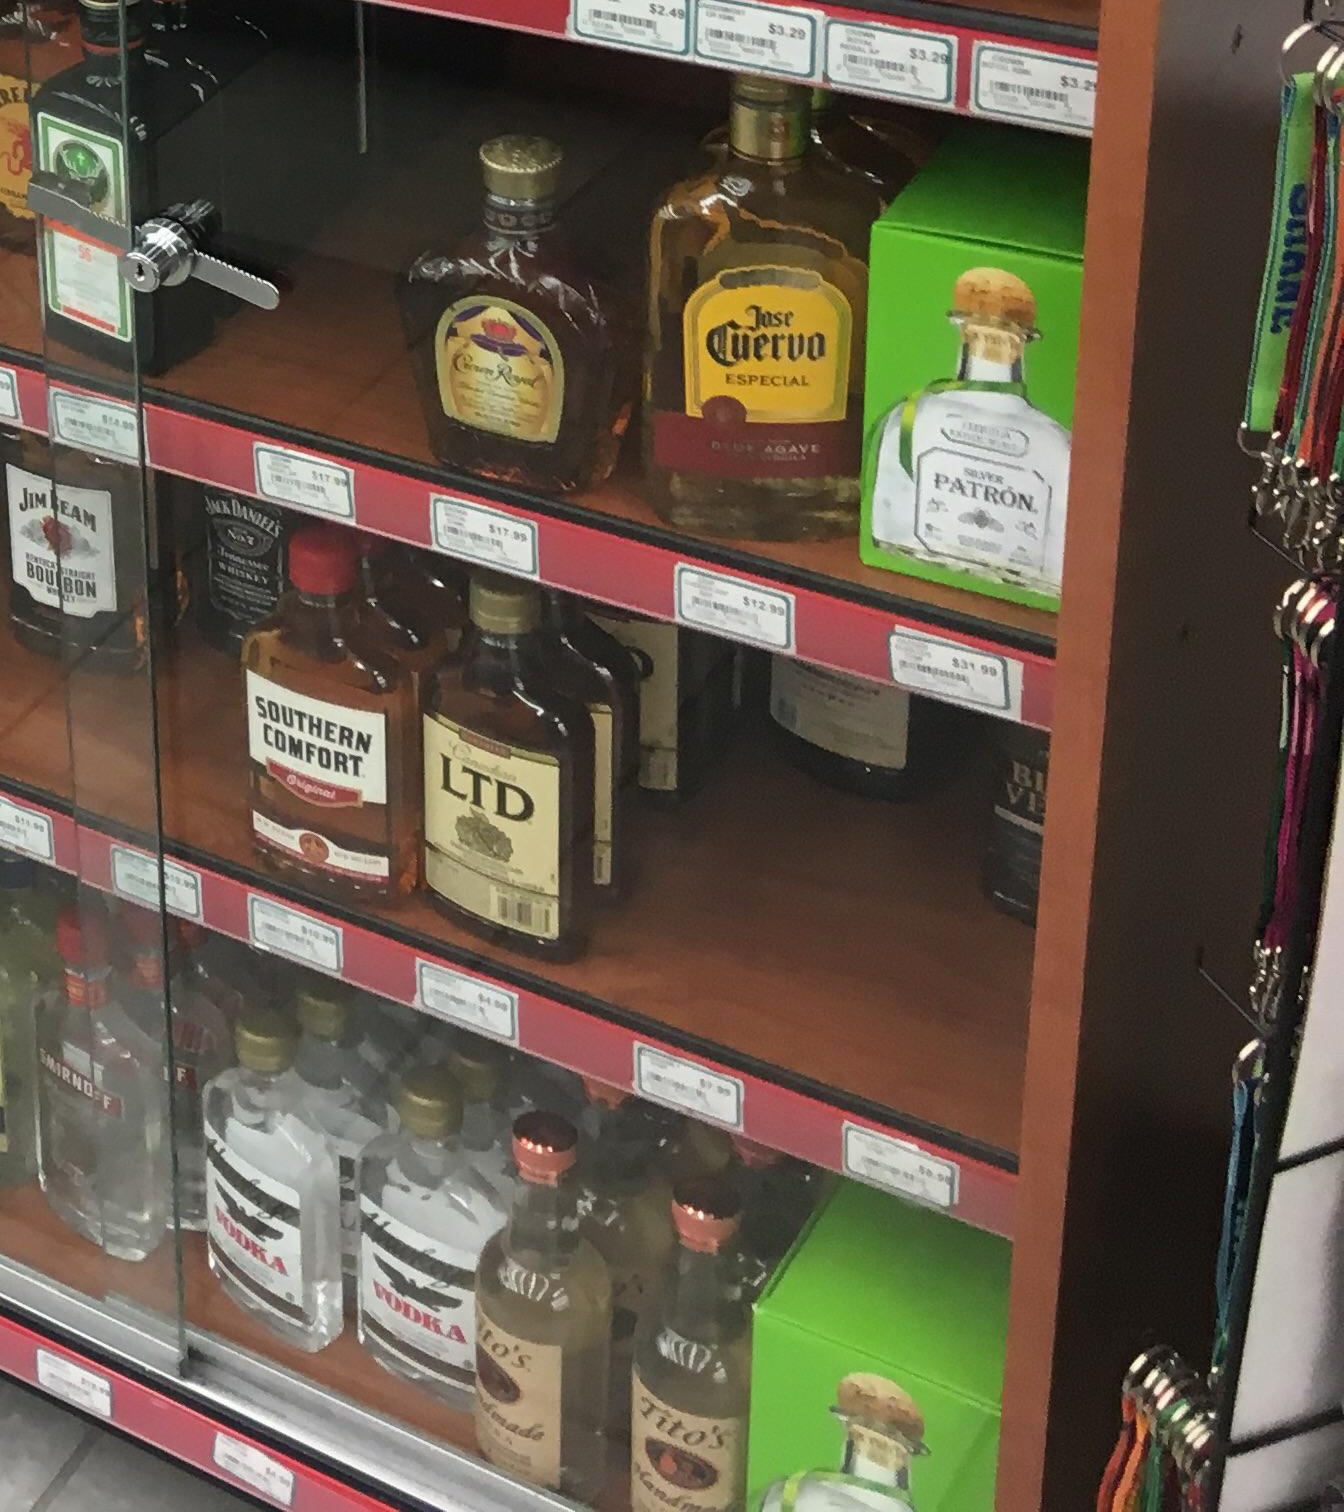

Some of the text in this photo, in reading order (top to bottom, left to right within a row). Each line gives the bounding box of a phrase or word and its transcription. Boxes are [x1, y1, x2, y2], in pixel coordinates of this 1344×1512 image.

[648, 1, 686, 21] $2.49
[768, 22, 807, 40] $3.29
[908, 47, 950, 65] $3.29
[745, 304, 794, 328] Jose
[706, 321, 825, 364] Cuervo
[725, 372, 809, 388] ESPECIAL
[963, 467, 1005, 484] SILVER
[19, 488, 46, 512] JIM
[255, 695, 373, 754] SOUTHERN
[262, 724, 365, 778] COMFORT
[438, 753, 536, 823] LTD
[214, 1208, 288, 1277] VODKA
[371, 1276, 468, 1345] VODKA
[638, 1393, 733, 1453] Tito's
